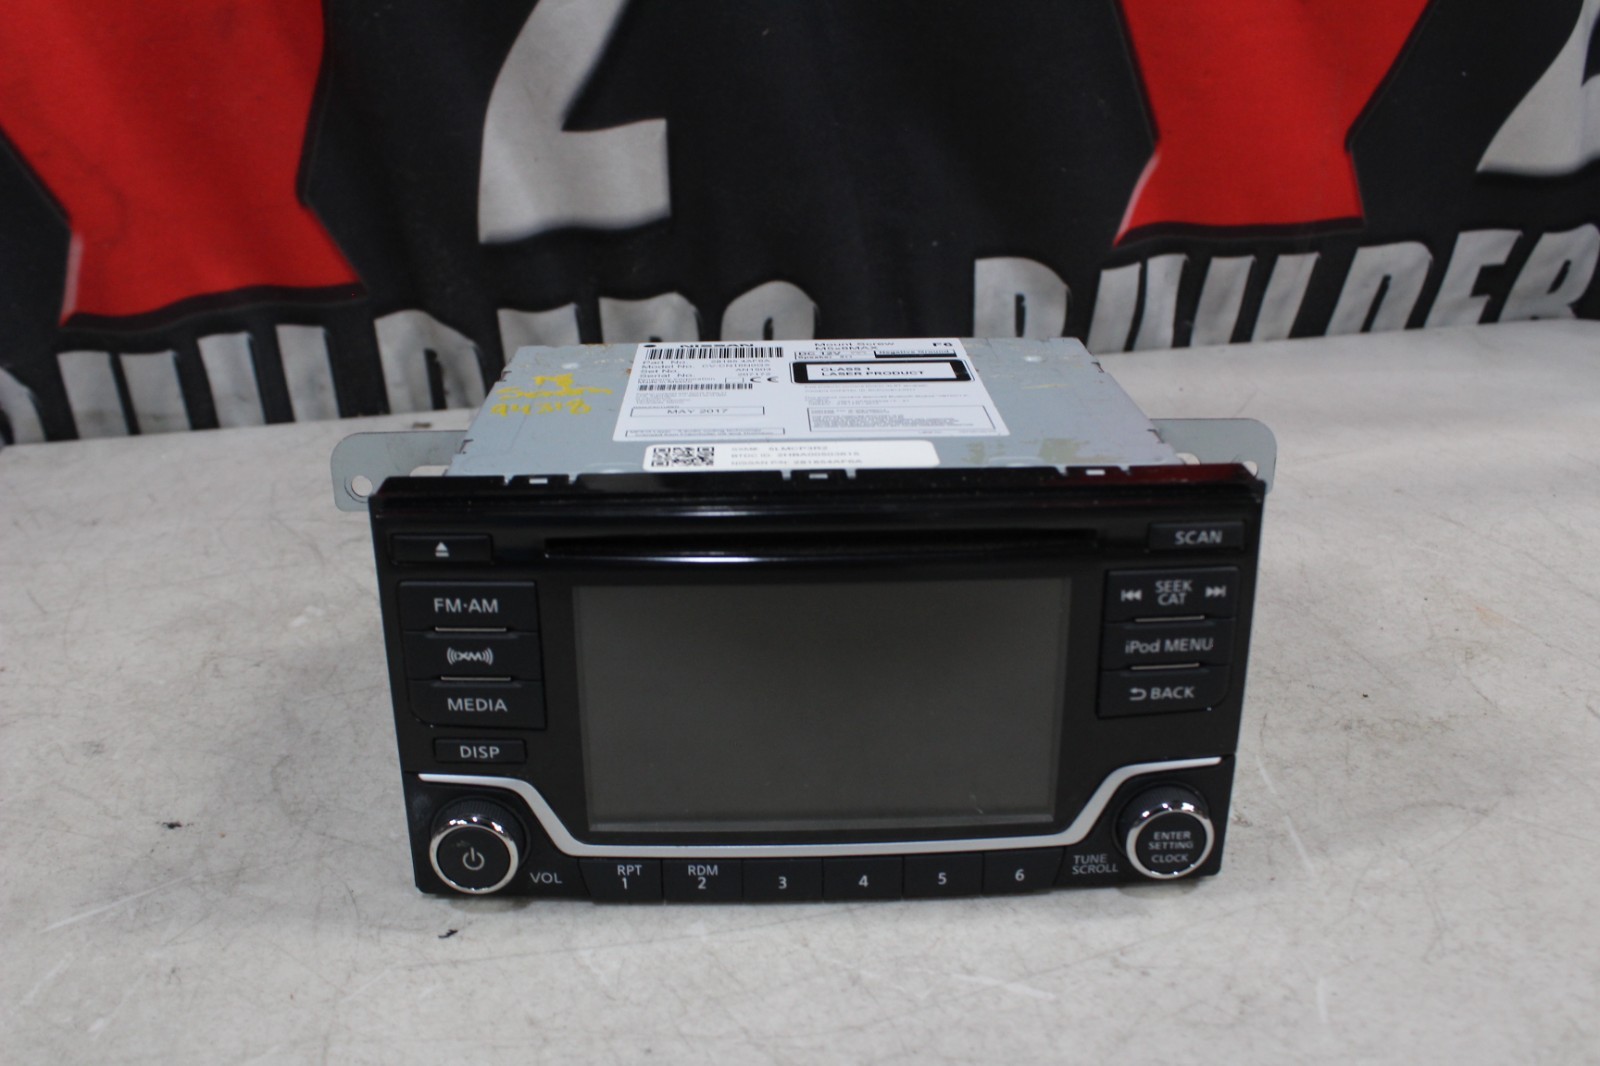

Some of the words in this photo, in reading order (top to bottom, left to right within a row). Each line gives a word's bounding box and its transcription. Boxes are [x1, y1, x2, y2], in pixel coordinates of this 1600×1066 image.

[1174, 530, 1223, 546] SCAN
[1155, 579, 1193, 594] SEEK
[1157, 592, 1187, 606] CAT
[1125, 639, 1161, 654] iPod
[1164, 637, 1215, 652] MENU
[1150, 686, 1195, 700] BACK
[446, 697, 508, 713] MEDIA
[459, 745, 500, 759] DISP
[1153, 830, 1192, 841] ENTER
[1148, 840, 1194, 851] SETTING
[1073, 853, 1108, 865] TUNE
[1151, 852, 1189, 864] CLOCK
[616, 864, 643, 877] RPT
[687, 864, 719, 877] RDM
[1014, 868, 1025, 882] 6
[1072, 862, 1119, 876] SCROLL
[529, 871, 563, 885] VOL
[621, 877, 629, 890] 1
[697, 876, 707, 890] 2
[777, 876, 788, 890] 3
[858, 874, 869, 888] 4
[937, 872, 947, 886] 5
